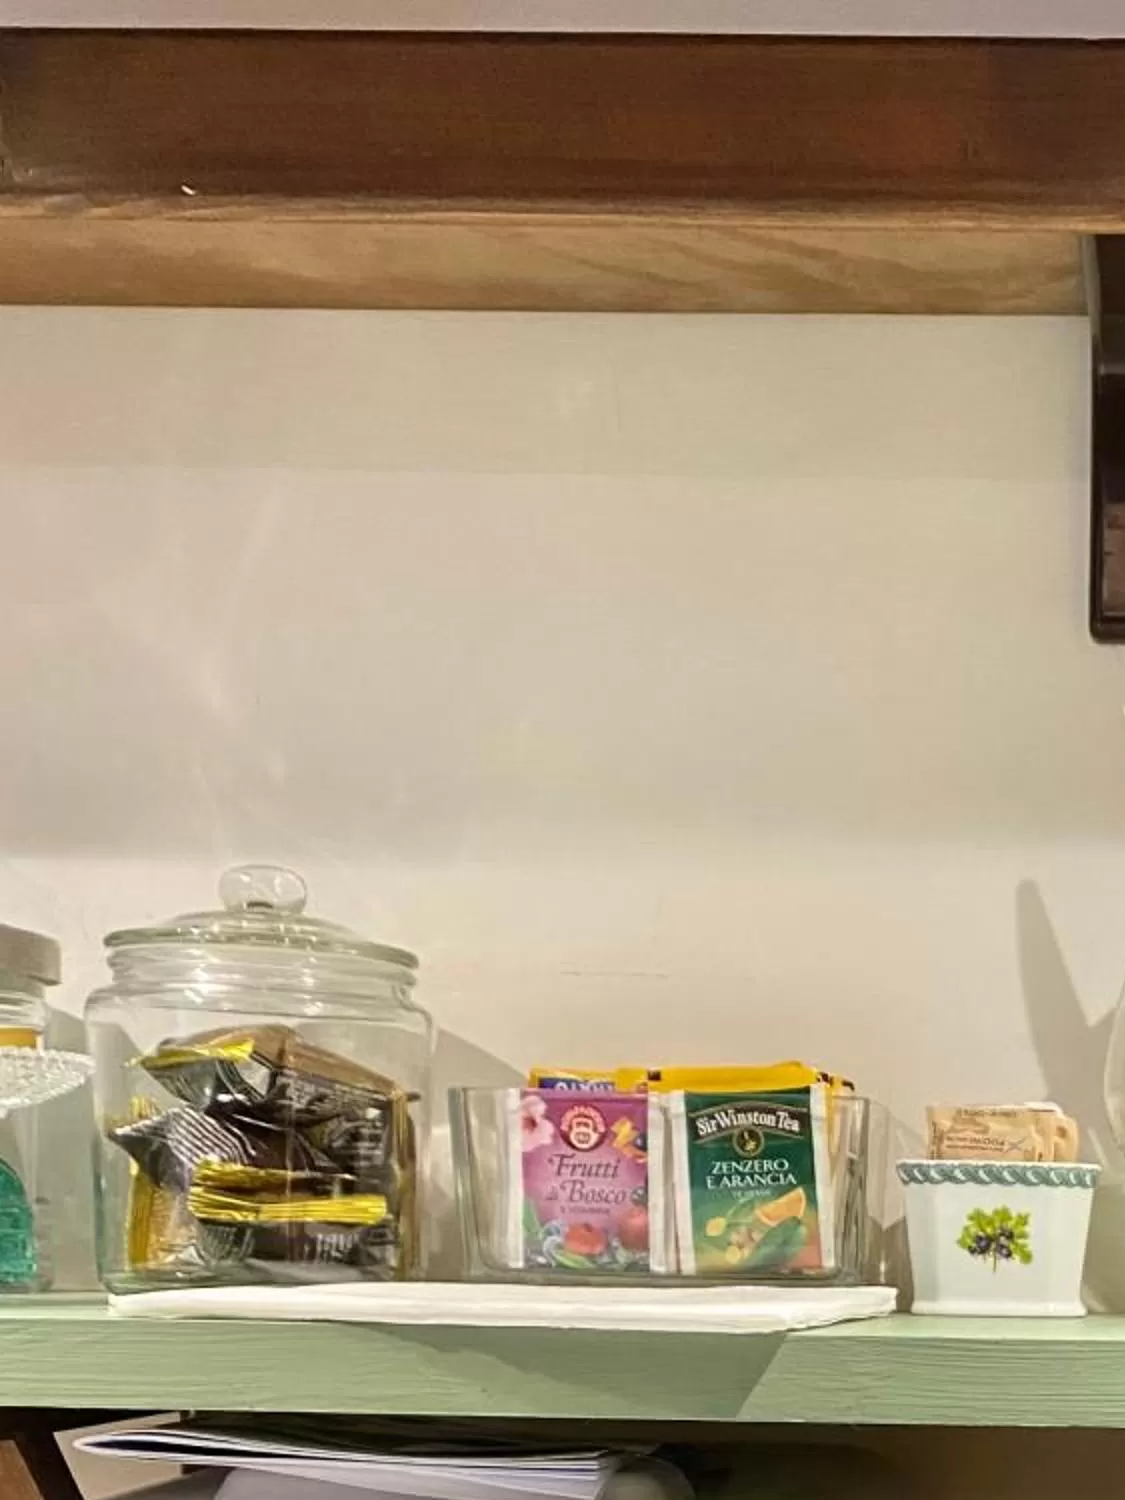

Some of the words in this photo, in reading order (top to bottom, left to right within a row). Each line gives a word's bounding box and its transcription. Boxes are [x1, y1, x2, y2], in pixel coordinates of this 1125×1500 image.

[696, 1115, 717, 1136] Sir
[714, 1108, 776, 1129] Winston
[775, 1111, 800, 1132] Tea
[548, 1153, 621, 1179] Frutti
[711, 1158, 790, 1175] ZENZERO
[559, 1179, 627, 1205] Bosco
[705, 1176, 718, 1189] E
[719, 1172, 798, 1188] ARANCIA
